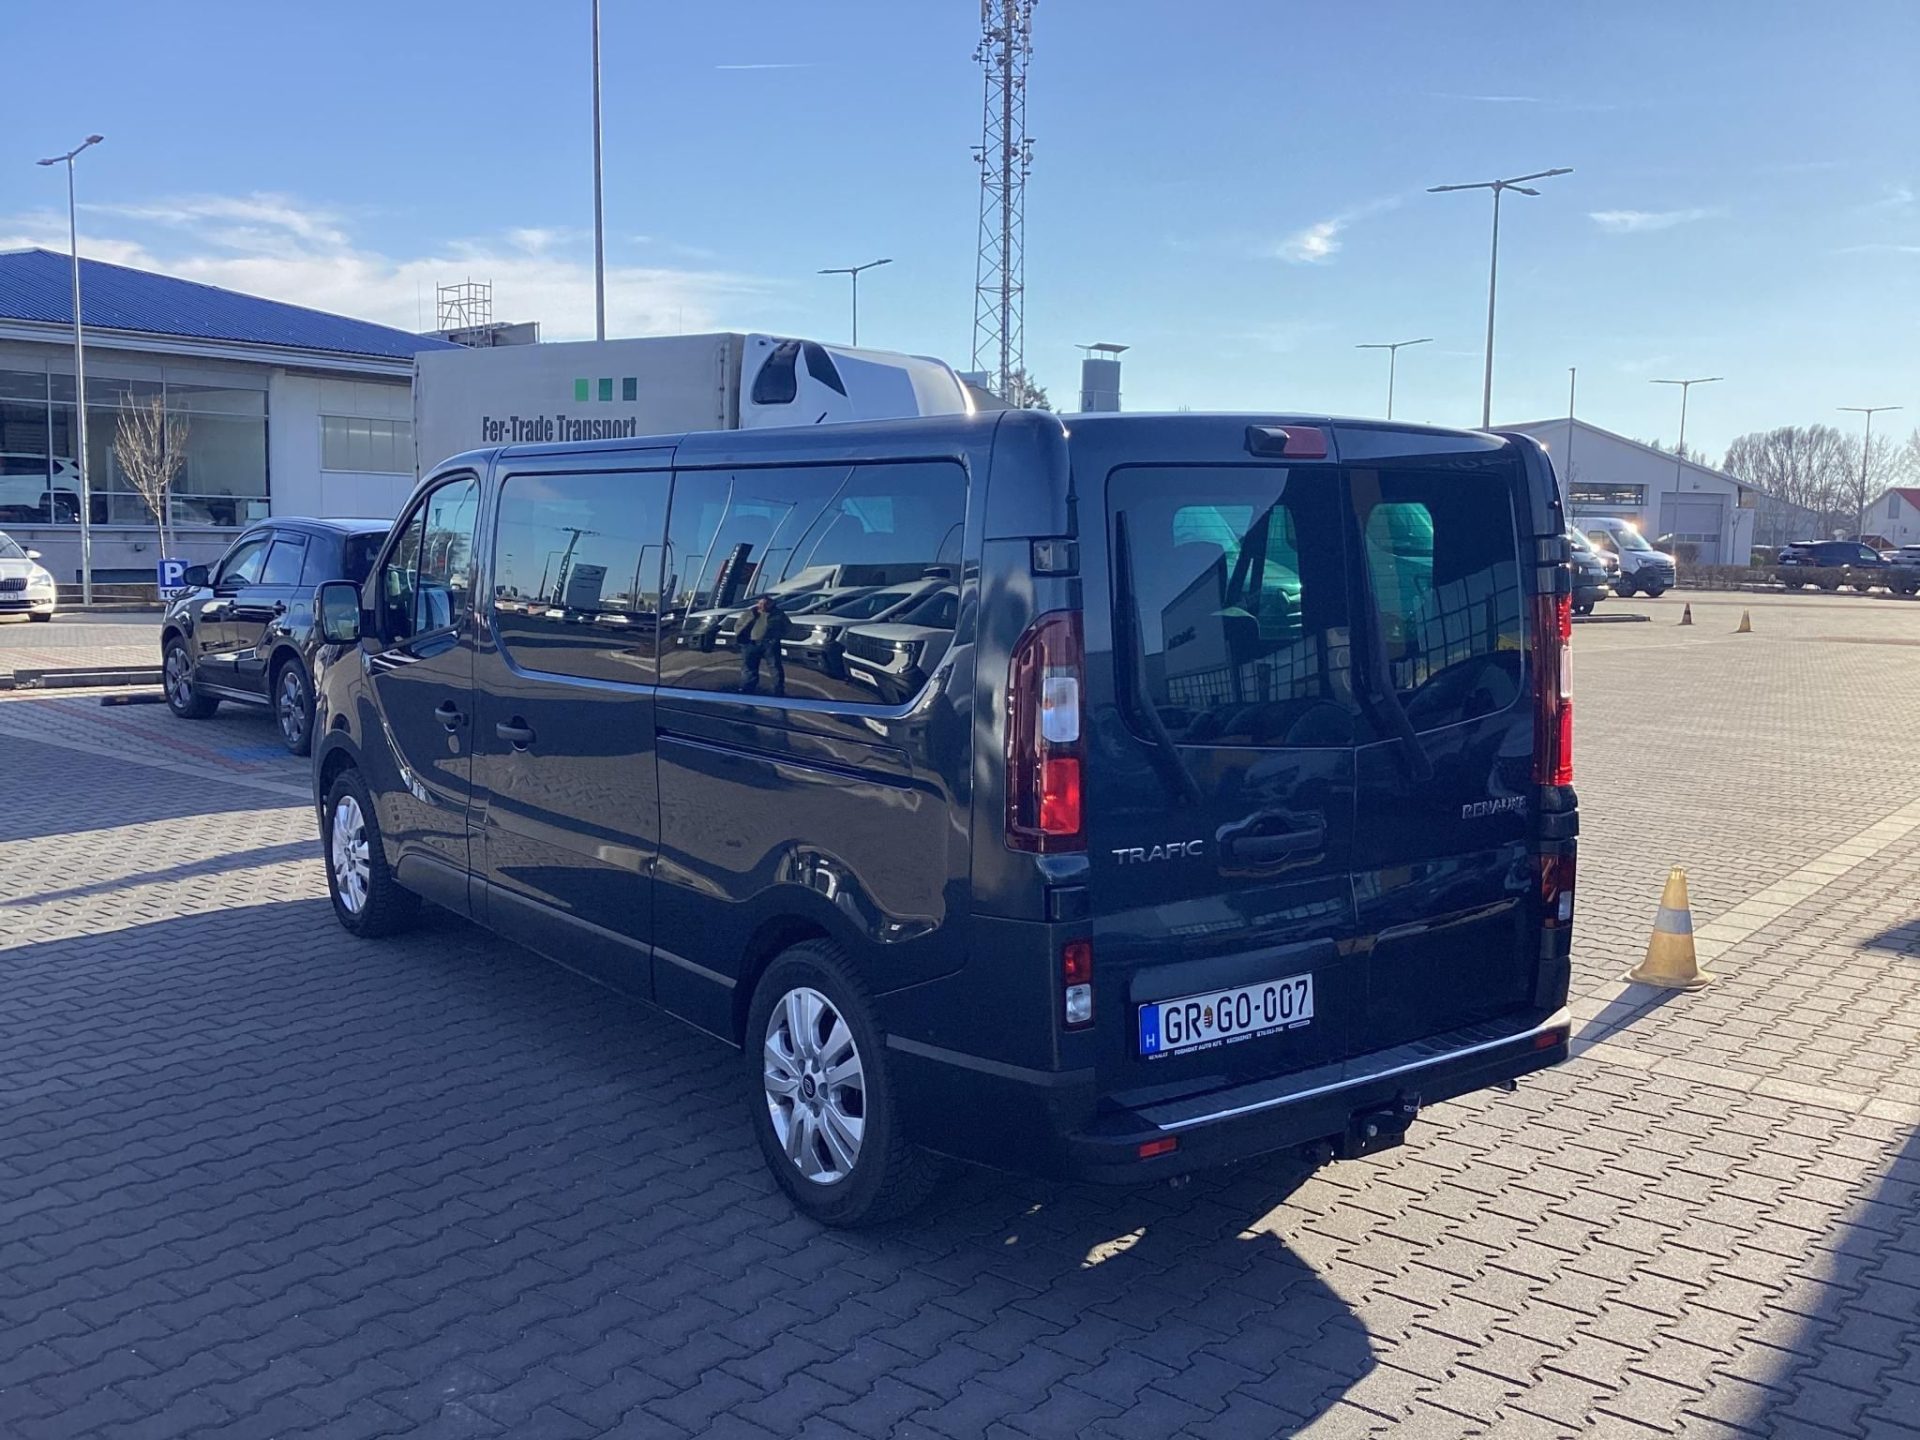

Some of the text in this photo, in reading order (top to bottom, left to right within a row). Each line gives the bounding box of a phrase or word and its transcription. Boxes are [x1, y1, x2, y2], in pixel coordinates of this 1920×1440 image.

[482, 415, 637, 442] Fer-Trade Transport
[164, 562, 183, 585] P
[1112, 840, 1203, 864] TRAFIC
[1146, 1033, 1155, 1048] H
